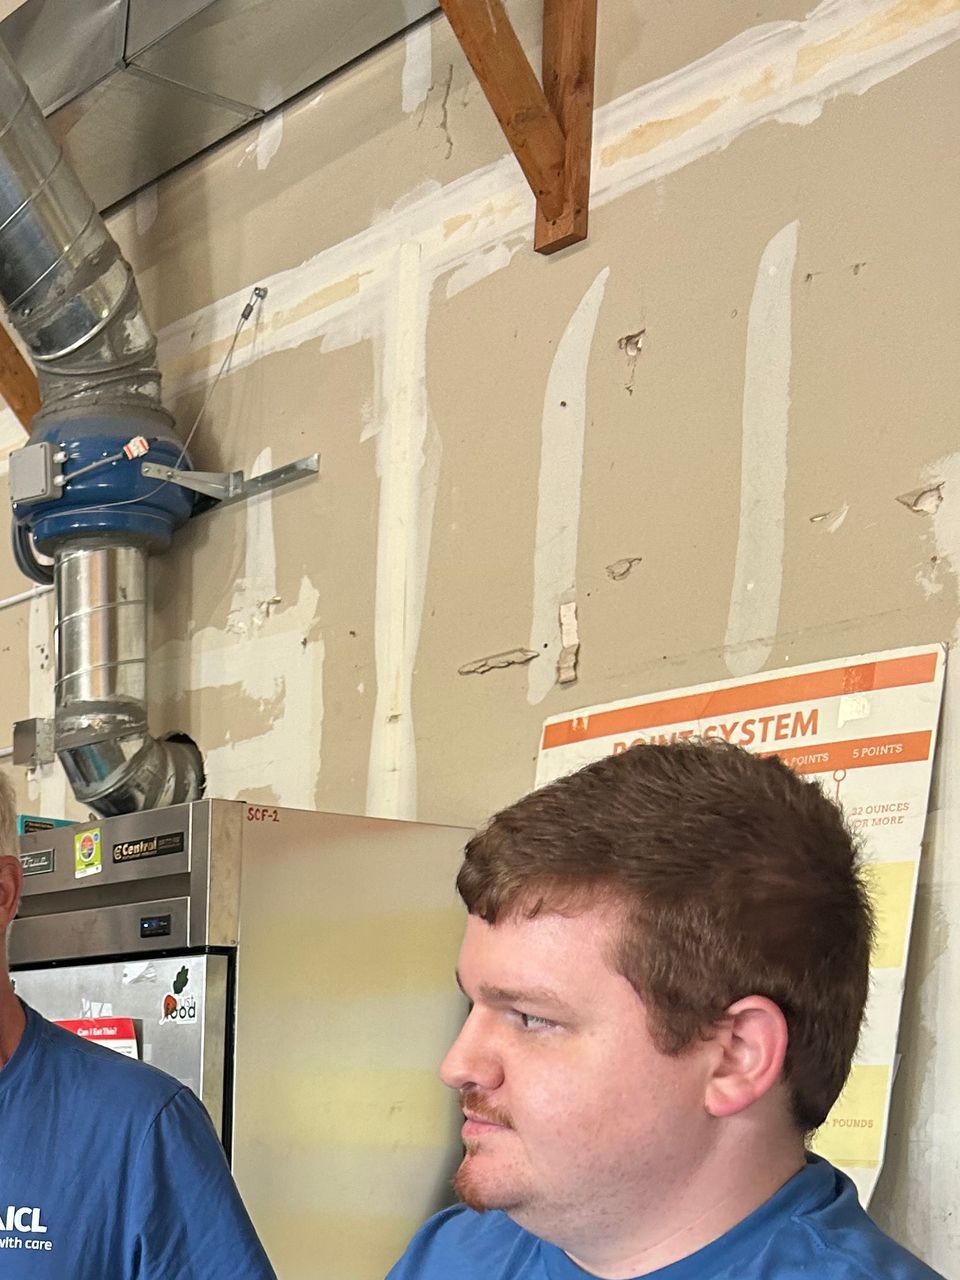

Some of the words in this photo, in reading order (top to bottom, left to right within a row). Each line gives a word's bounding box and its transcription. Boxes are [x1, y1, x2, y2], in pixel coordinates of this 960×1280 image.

[852, 748, 860, 759] 5
[861, 743, 903, 757] POINTS
[247, 806, 280, 822] SCF-2
[865, 802, 910, 815] OUNCES
[871, 815, 905, 827] MORE
[832, 1118, 874, 1129] POUNDS
[24, 1239, 53, 1251] care
